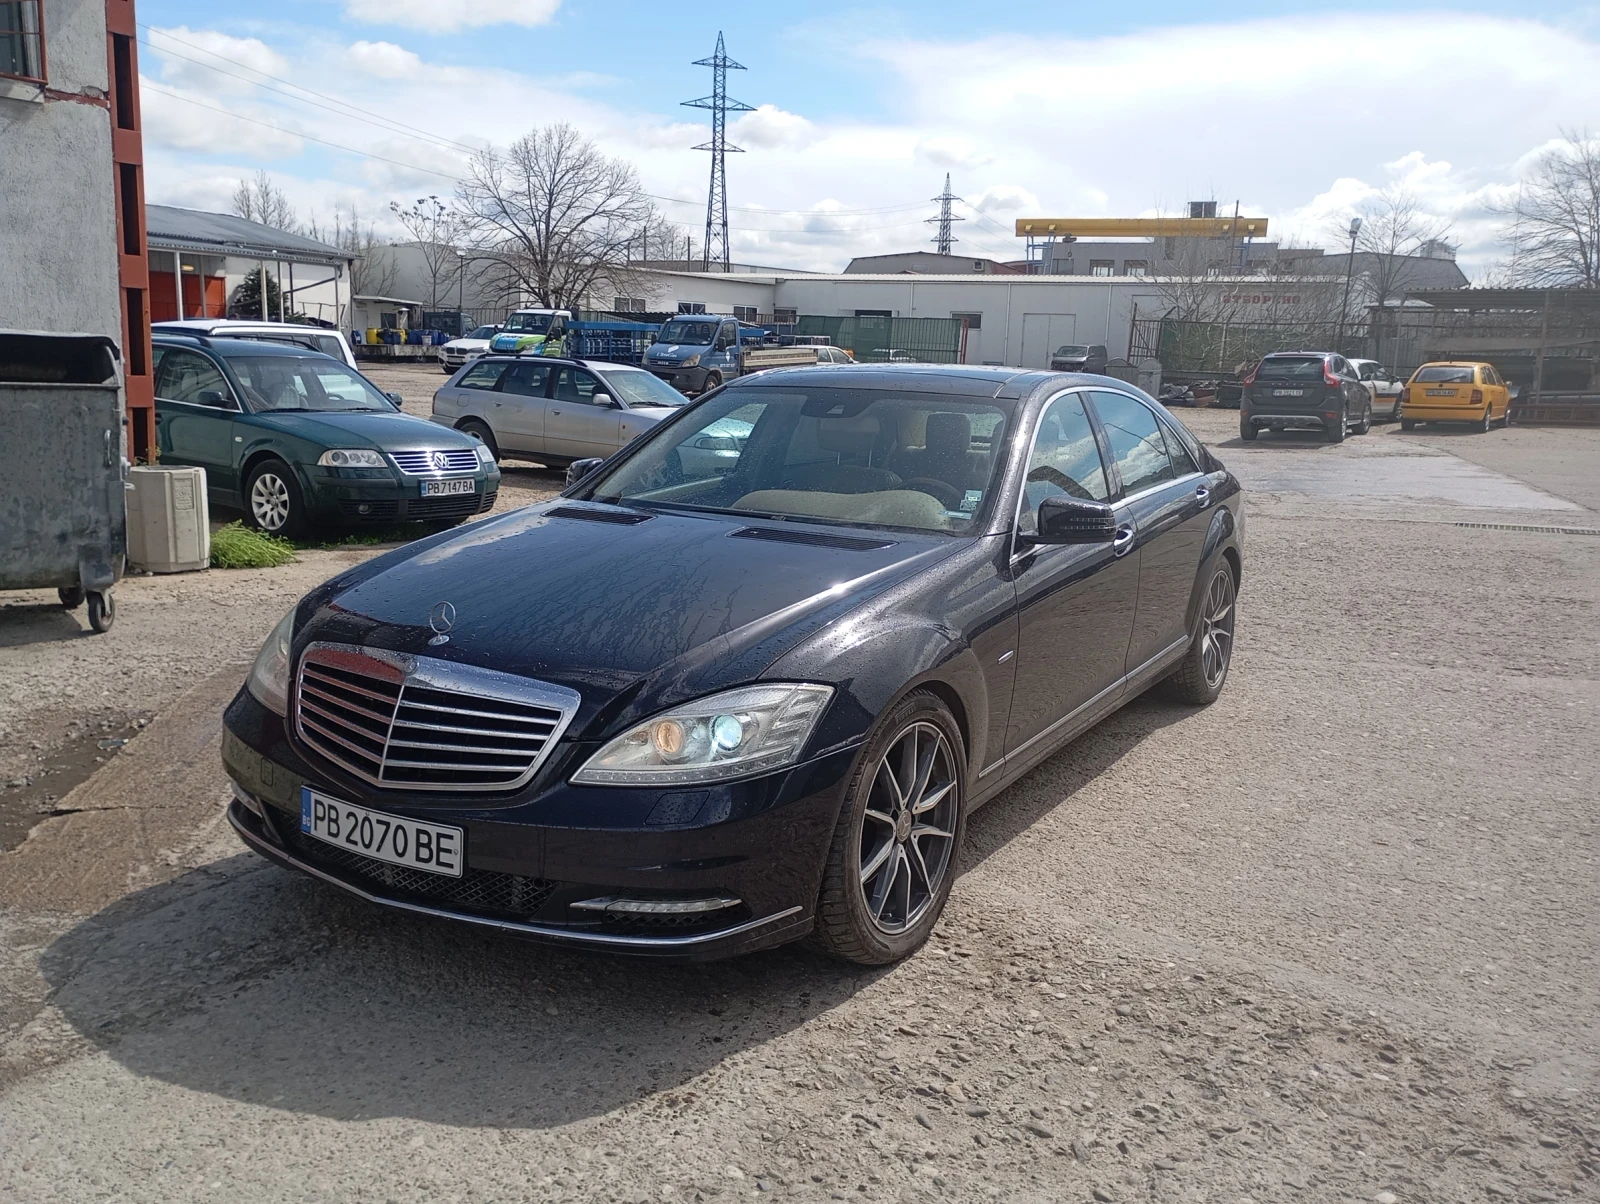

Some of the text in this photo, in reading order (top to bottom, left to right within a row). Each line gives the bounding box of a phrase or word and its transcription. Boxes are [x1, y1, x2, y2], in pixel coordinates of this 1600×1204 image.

[428, 481, 474, 494] PB 7147 BA
[302, 815, 311, 827] BG
[313, 798, 455, 870] PB 2070 BE
